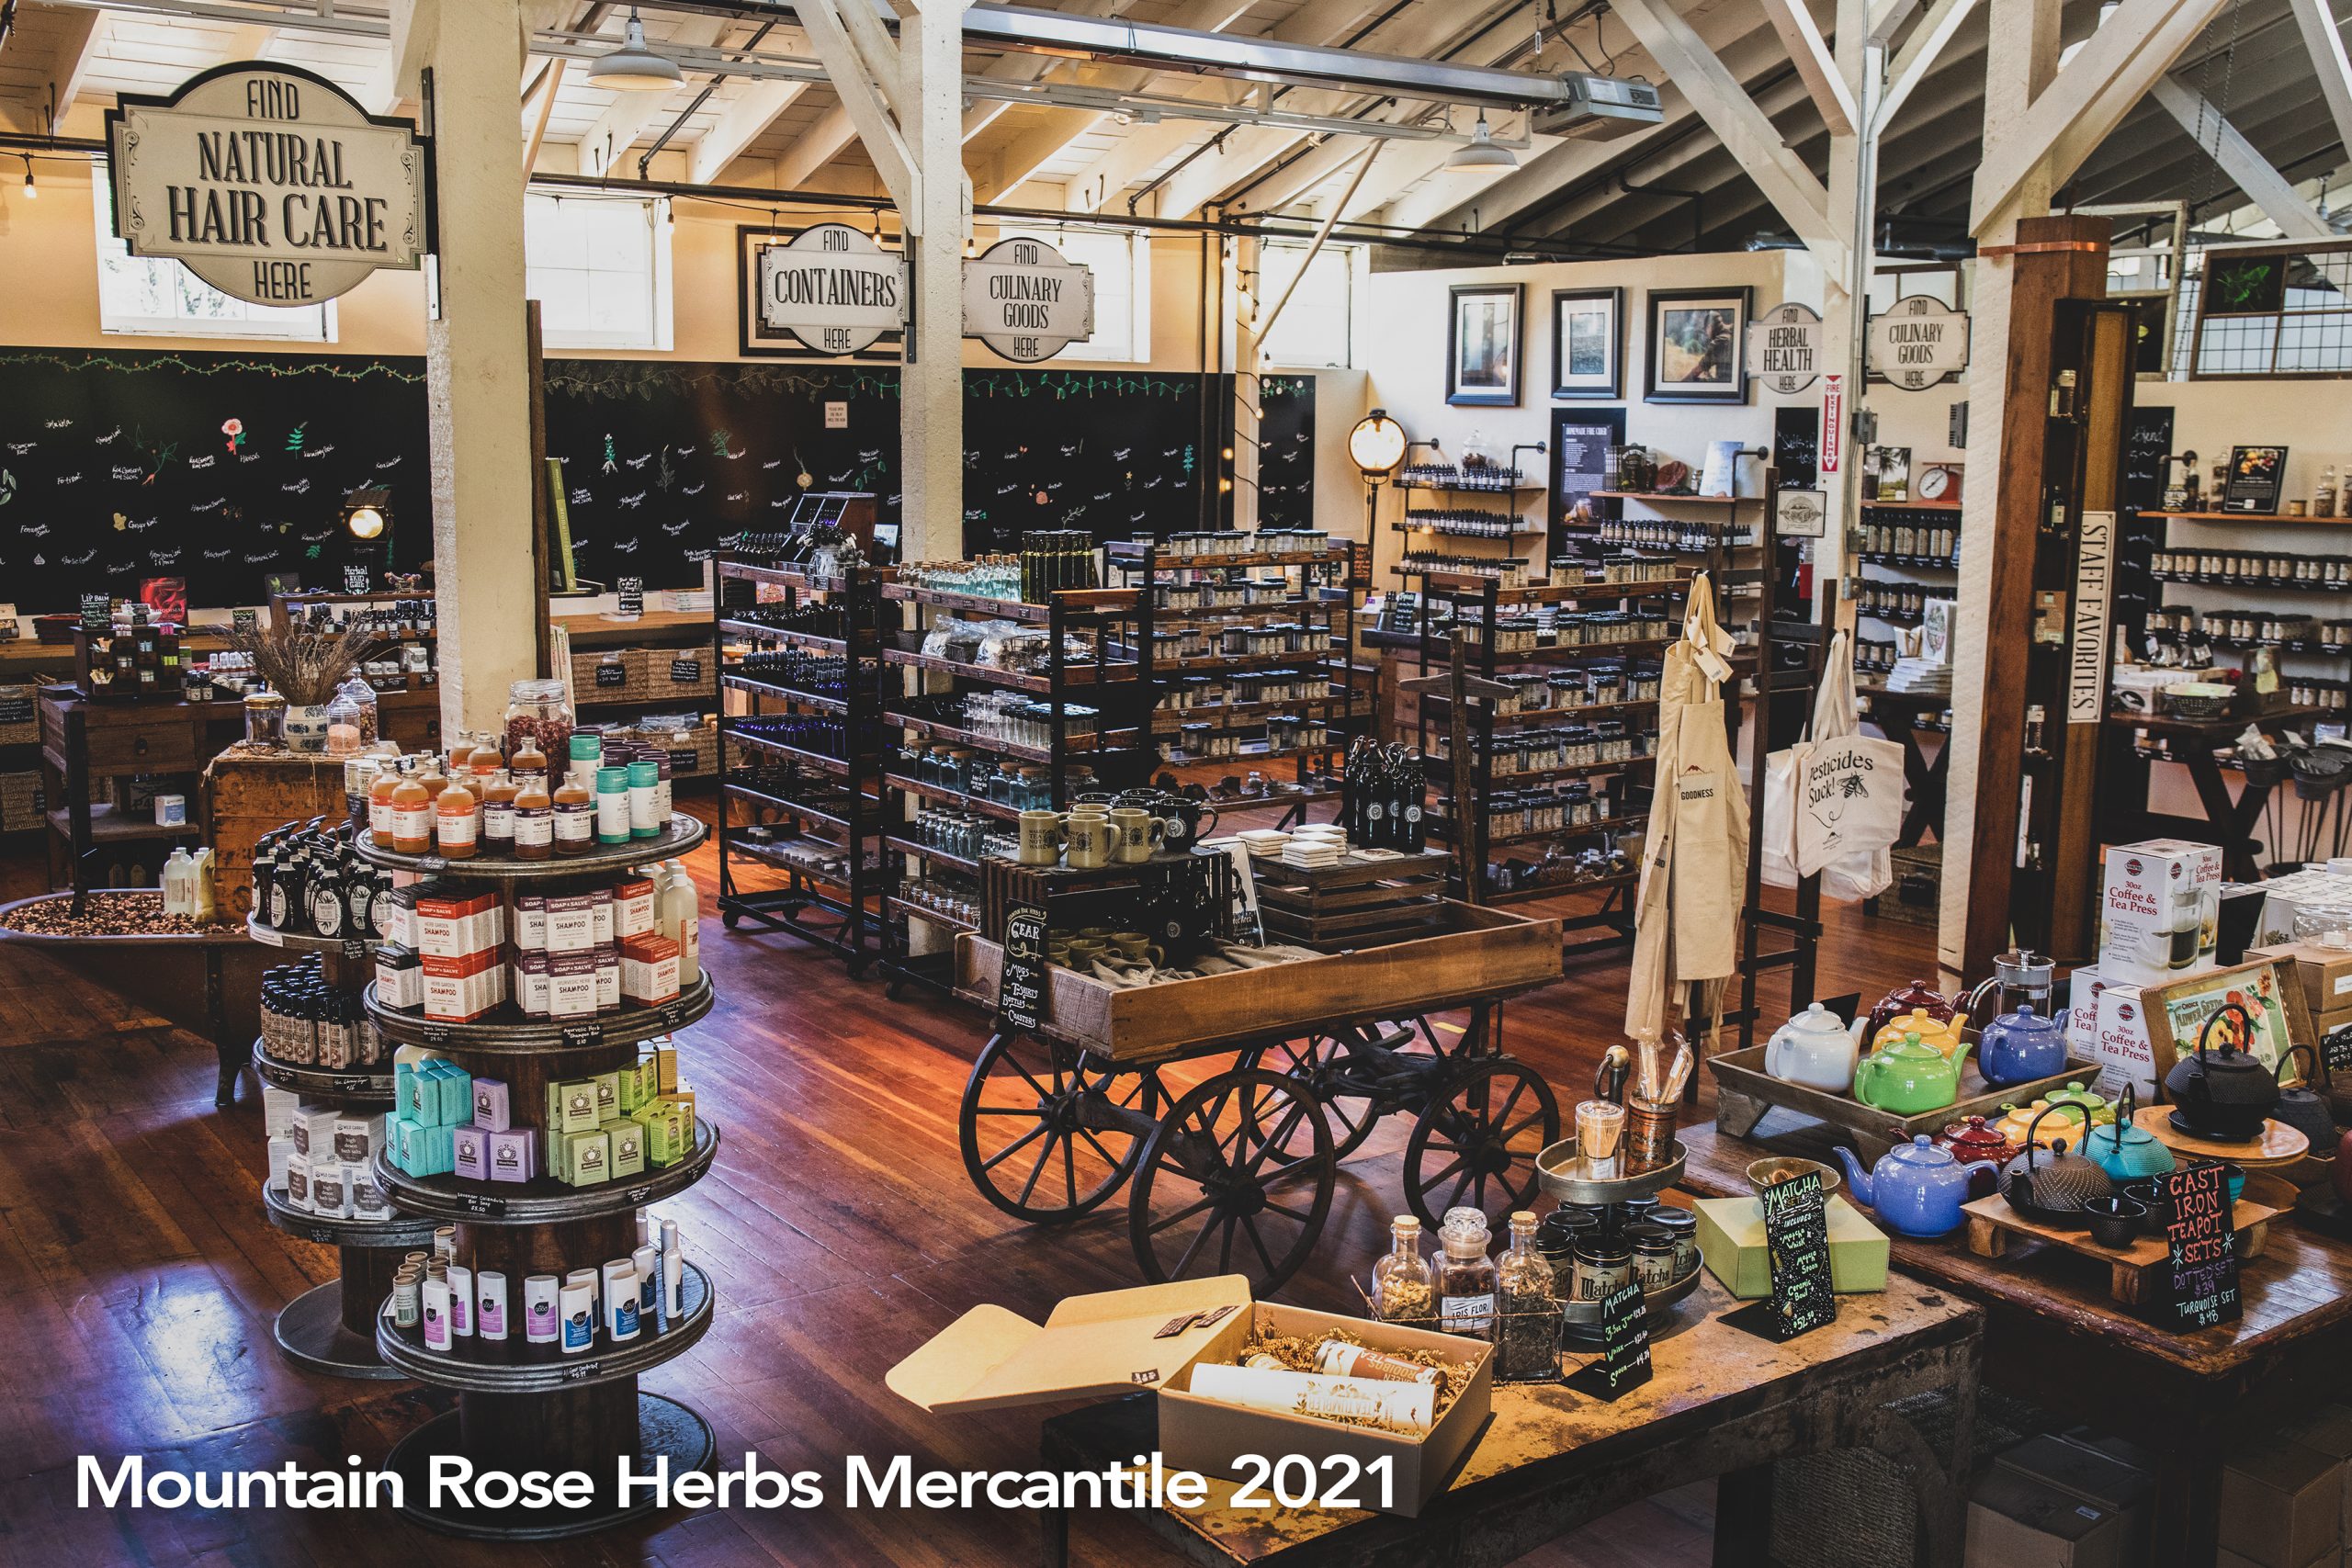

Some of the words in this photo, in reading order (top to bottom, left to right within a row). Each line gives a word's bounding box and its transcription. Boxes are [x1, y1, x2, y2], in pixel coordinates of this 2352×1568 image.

[246, 79, 300, 120] FIND
[198, 131, 352, 189] NATURAL
[166, 185, 270, 246] HAIR
[283, 193, 388, 252] CARE
[823, 230, 849, 252] FIND
[1013, 243, 1038, 265] FIND
[254, 261, 313, 299] HERE
[775, 269, 897, 309] CONTAINERS
[989, 276, 1062, 303] CULINARY
[1003, 303, 1049, 329] GOODS
[1782, 309, 1798, 322] FIND
[1909, 299, 1928, 315] FIND
[824, 328, 852, 350] HERE
[1769, 327, 1809, 349] HERBAL
[1889, 323, 1944, 344] CULINARY
[1013, 337, 1039, 357] HERE
[1898, 344, 1934, 364] GOODS
[1763, 348, 1813, 372] HEALTH
[1779, 376, 1796, 390] HERE
[1826, 384, 1840, 392] FIRE
[1905, 371, 1925, 387] HERE
[1827, 394, 1836, 464] EXTINGUISHER
[2078, 525, 2109, 591] STAFF
[81, 593, 94, 603] LIP
[94, 594, 109, 603] BALM
[2072, 598, 2103, 710] FAVORITES
[1680, 788, 1714, 801] GOODNESS
[1808, 776, 1835, 808] Suck!
[2196, 862, 2213, 874] Coffee
[2214, 862, 2220, 870] &
[2196, 874, 2205, 883] Tea
[2206, 871, 2221, 882] Press
[2125, 881, 2142, 890] 30oz
[2109, 886, 2144, 902] Coffee
[2146, 895, 2156, 905] &
[629, 905, 650, 916] SHAMPOO
[2109, 897, 2128, 909] Tea
[2130, 901, 2158, 916] Press
[424, 928, 450, 937] SHAMPOO
[556, 920, 586, 931] SHAMPOO
[1011, 921, 1040, 941] GEAR
[657, 967, 676, 979] SHAMPOO
[430, 987, 457, 996] SHAMPOO
[559, 985, 589, 994] SHAMPOO
[2075, 1008, 2097, 1021] Coff
[2075, 1019, 2093, 1031] Tea
[2117, 1025, 2133, 1035] 30oz
[2101, 1031, 2136, 1047] Coffee
[2138, 1040, 2149, 1050] &
[2101, 1041, 2120, 1053] Tea
[2121, 1044, 2150, 1063] Press
[2169, 1166, 2224, 1196] CAST
[1767, 1175, 1821, 1216] MATCHA
[1787, 1197, 1802, 1208] SET
[2175, 1190, 2219, 1220] IRON
[1783, 1213, 1812, 1228] INCLUDES
[2167, 1210, 2223, 1242] TEAPOT
[2185, 1237, 2222, 1263] SETS
[2174, 1265, 2212, 1291] DOTTED
[2214, 1258, 2234, 1276] SET
[1787, 1279, 1812, 1296] Ceramic
[2194, 1280, 2215, 1297] $39
[1604, 1283, 1640, 1319] MATCHA
[2176, 1294, 2218, 1317] TURQUOISE
[2222, 1289, 2235, 1304] SET
[2199, 1310, 2219, 1325] $48
[1360, 1348, 1383, 1364] TEA
[1367, 1359, 1417, 1379] ROOIBOS
[1308, 1396, 1353, 1415] TUMBLER
[1355, 1403, 1373, 1416] TEA
